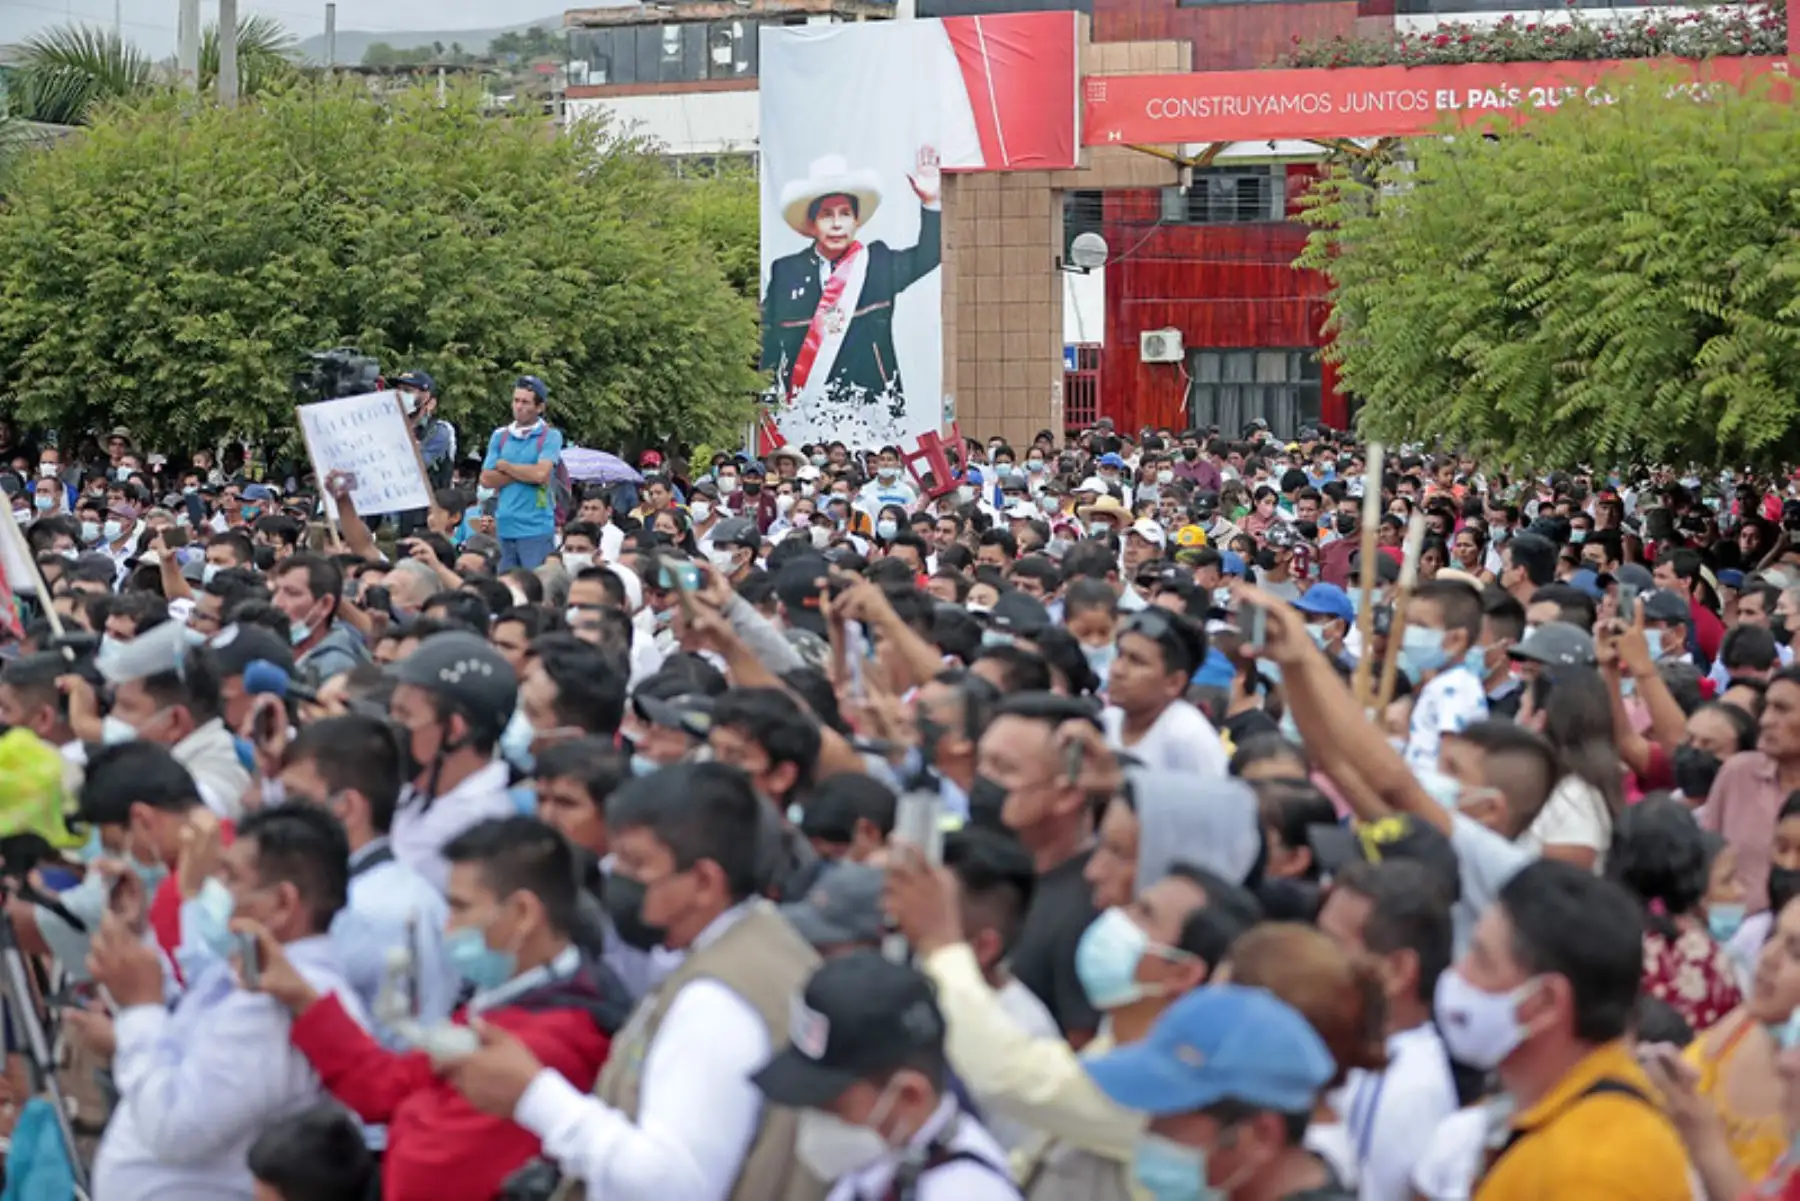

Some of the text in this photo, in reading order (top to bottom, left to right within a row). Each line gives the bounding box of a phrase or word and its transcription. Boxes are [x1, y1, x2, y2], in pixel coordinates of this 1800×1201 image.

[1145, 92, 1333, 120] CONSTRUYAMOS
[1338, 89, 1429, 114] JUNTOS
[1435, 89, 1461, 109] EL
[1467, 82, 1521, 109] PAÍS
